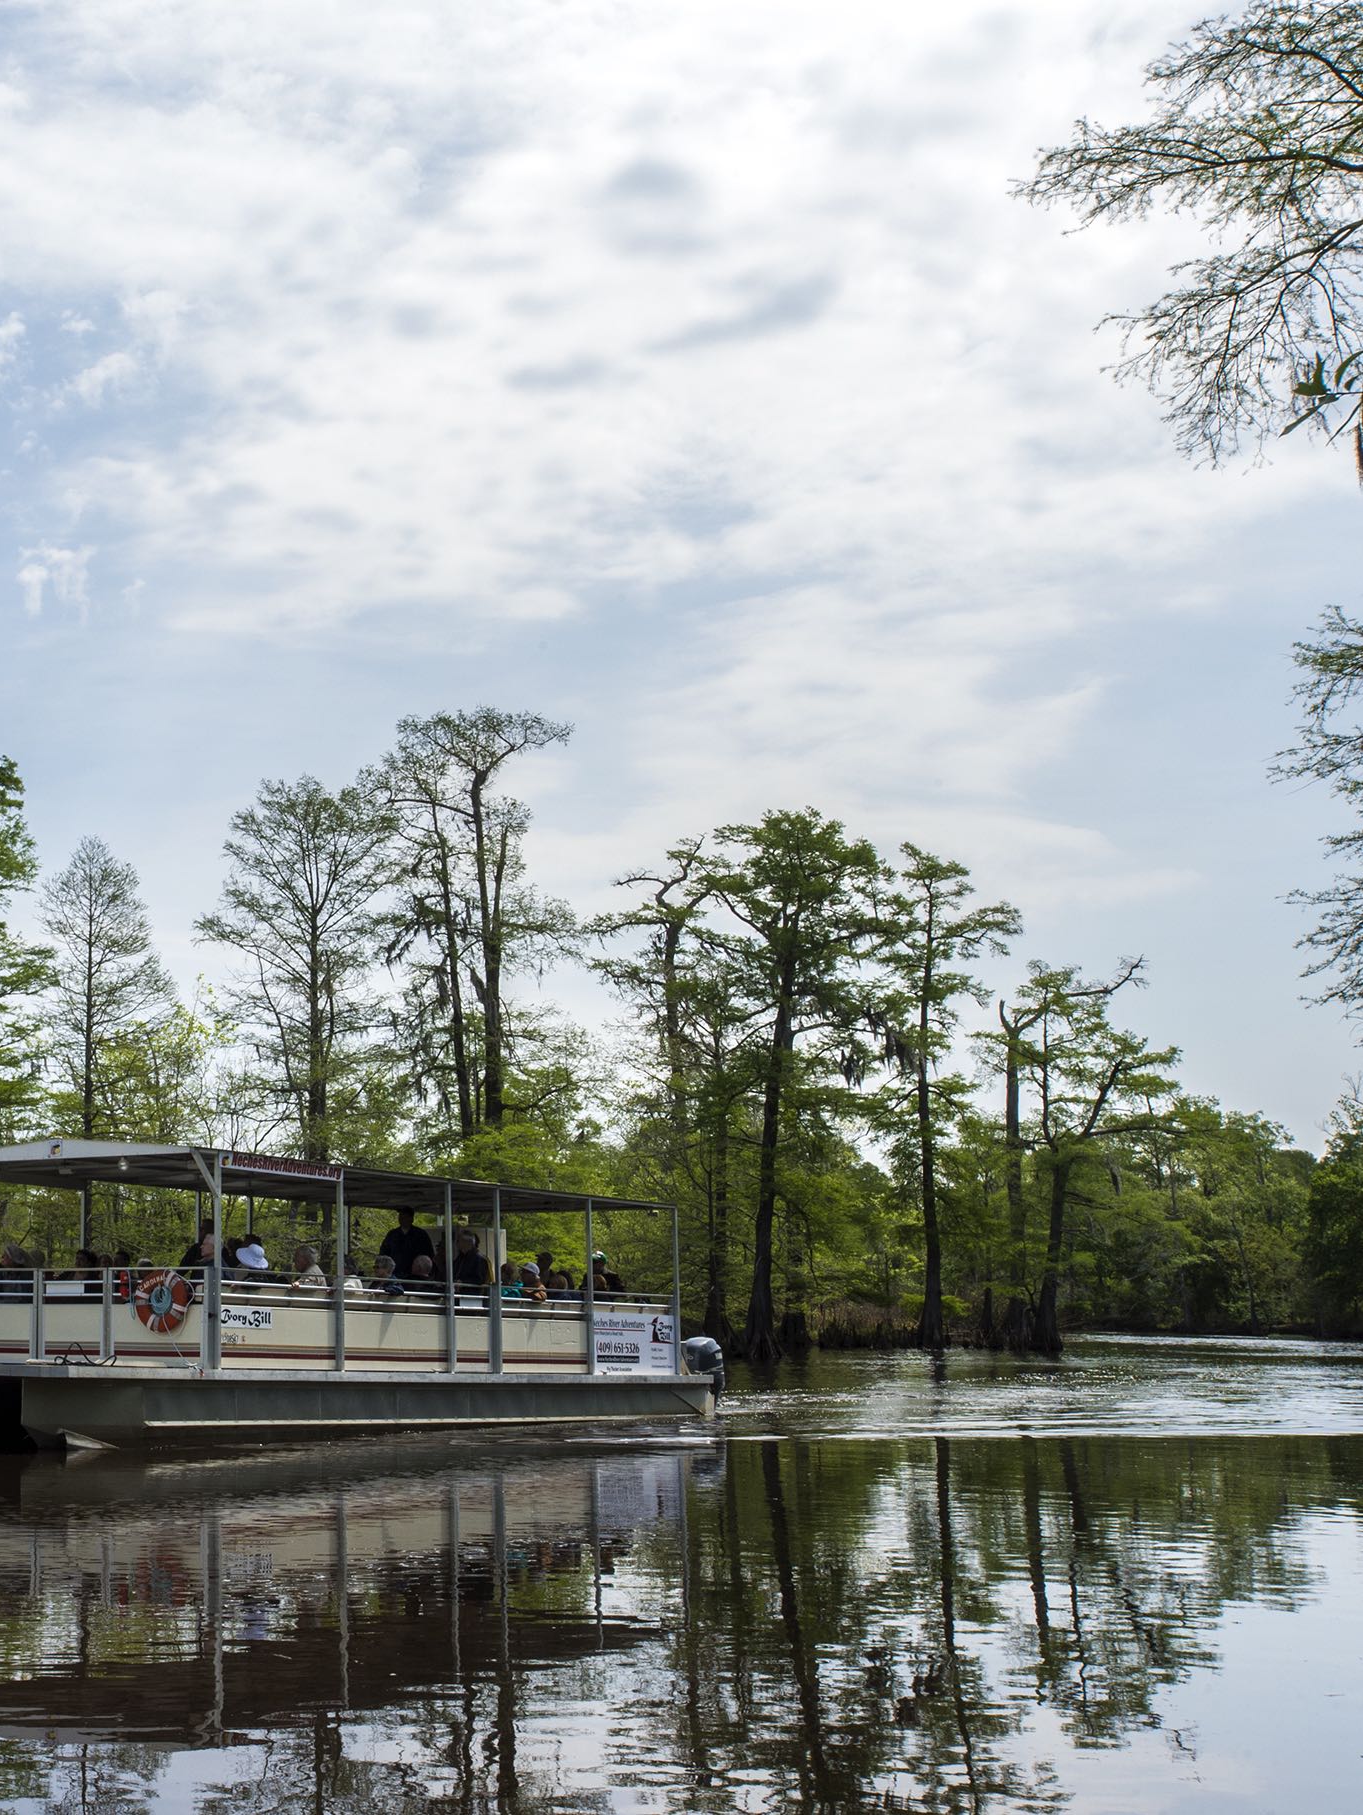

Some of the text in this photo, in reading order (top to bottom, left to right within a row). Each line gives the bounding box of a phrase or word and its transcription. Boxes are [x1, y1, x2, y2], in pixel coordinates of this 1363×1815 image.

[231, 1152, 342, 1180] NechesRiverAdventures.org
[220, 1308, 272, 1327] Ivory Bill
[609, 1319, 620, 1328] River
[621, 1319, 646, 1329] Adventures
[596, 1340, 640, 1355] (409) 651-5326
